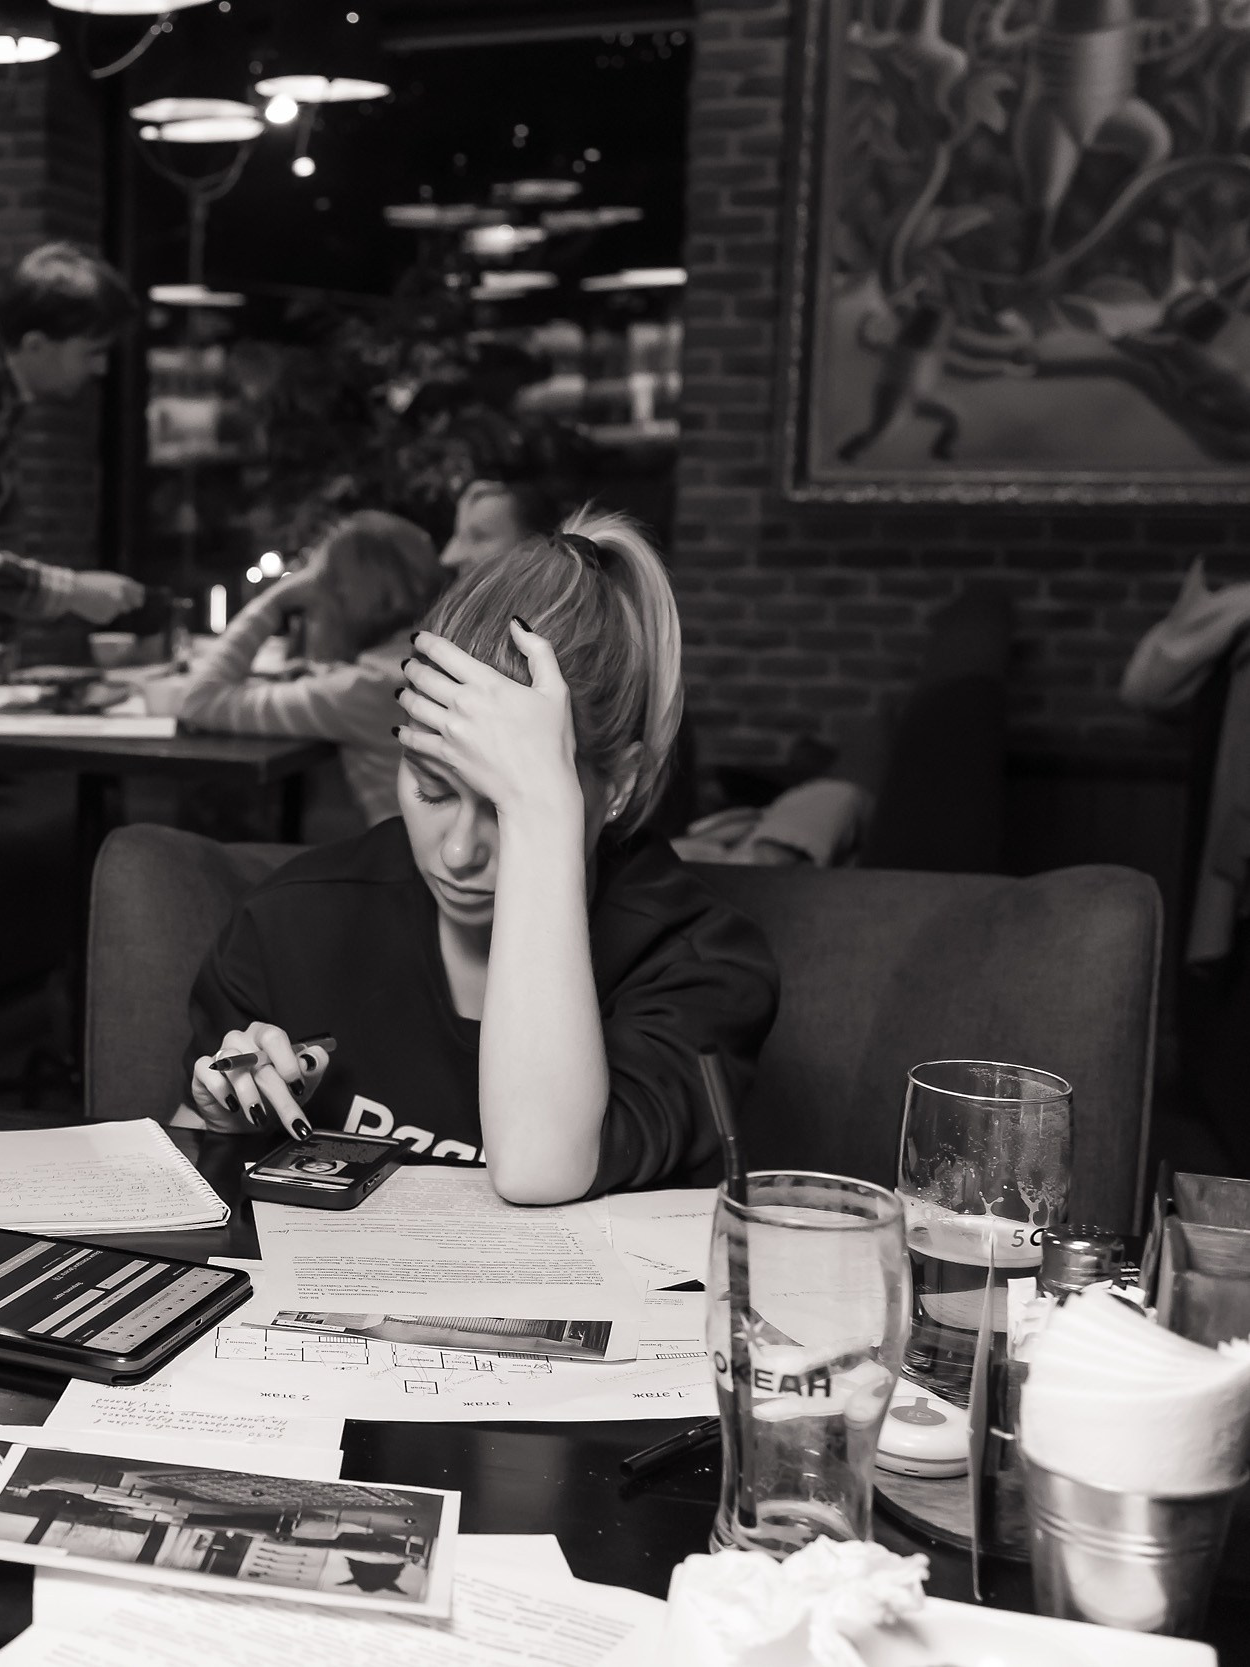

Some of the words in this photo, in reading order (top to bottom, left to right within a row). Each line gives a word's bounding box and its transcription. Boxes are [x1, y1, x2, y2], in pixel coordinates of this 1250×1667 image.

[259, 1392, 297, 1400] этаж
[301, 1394, 311, 1402] 2
[632, 1391, 671, 1399] этаж
